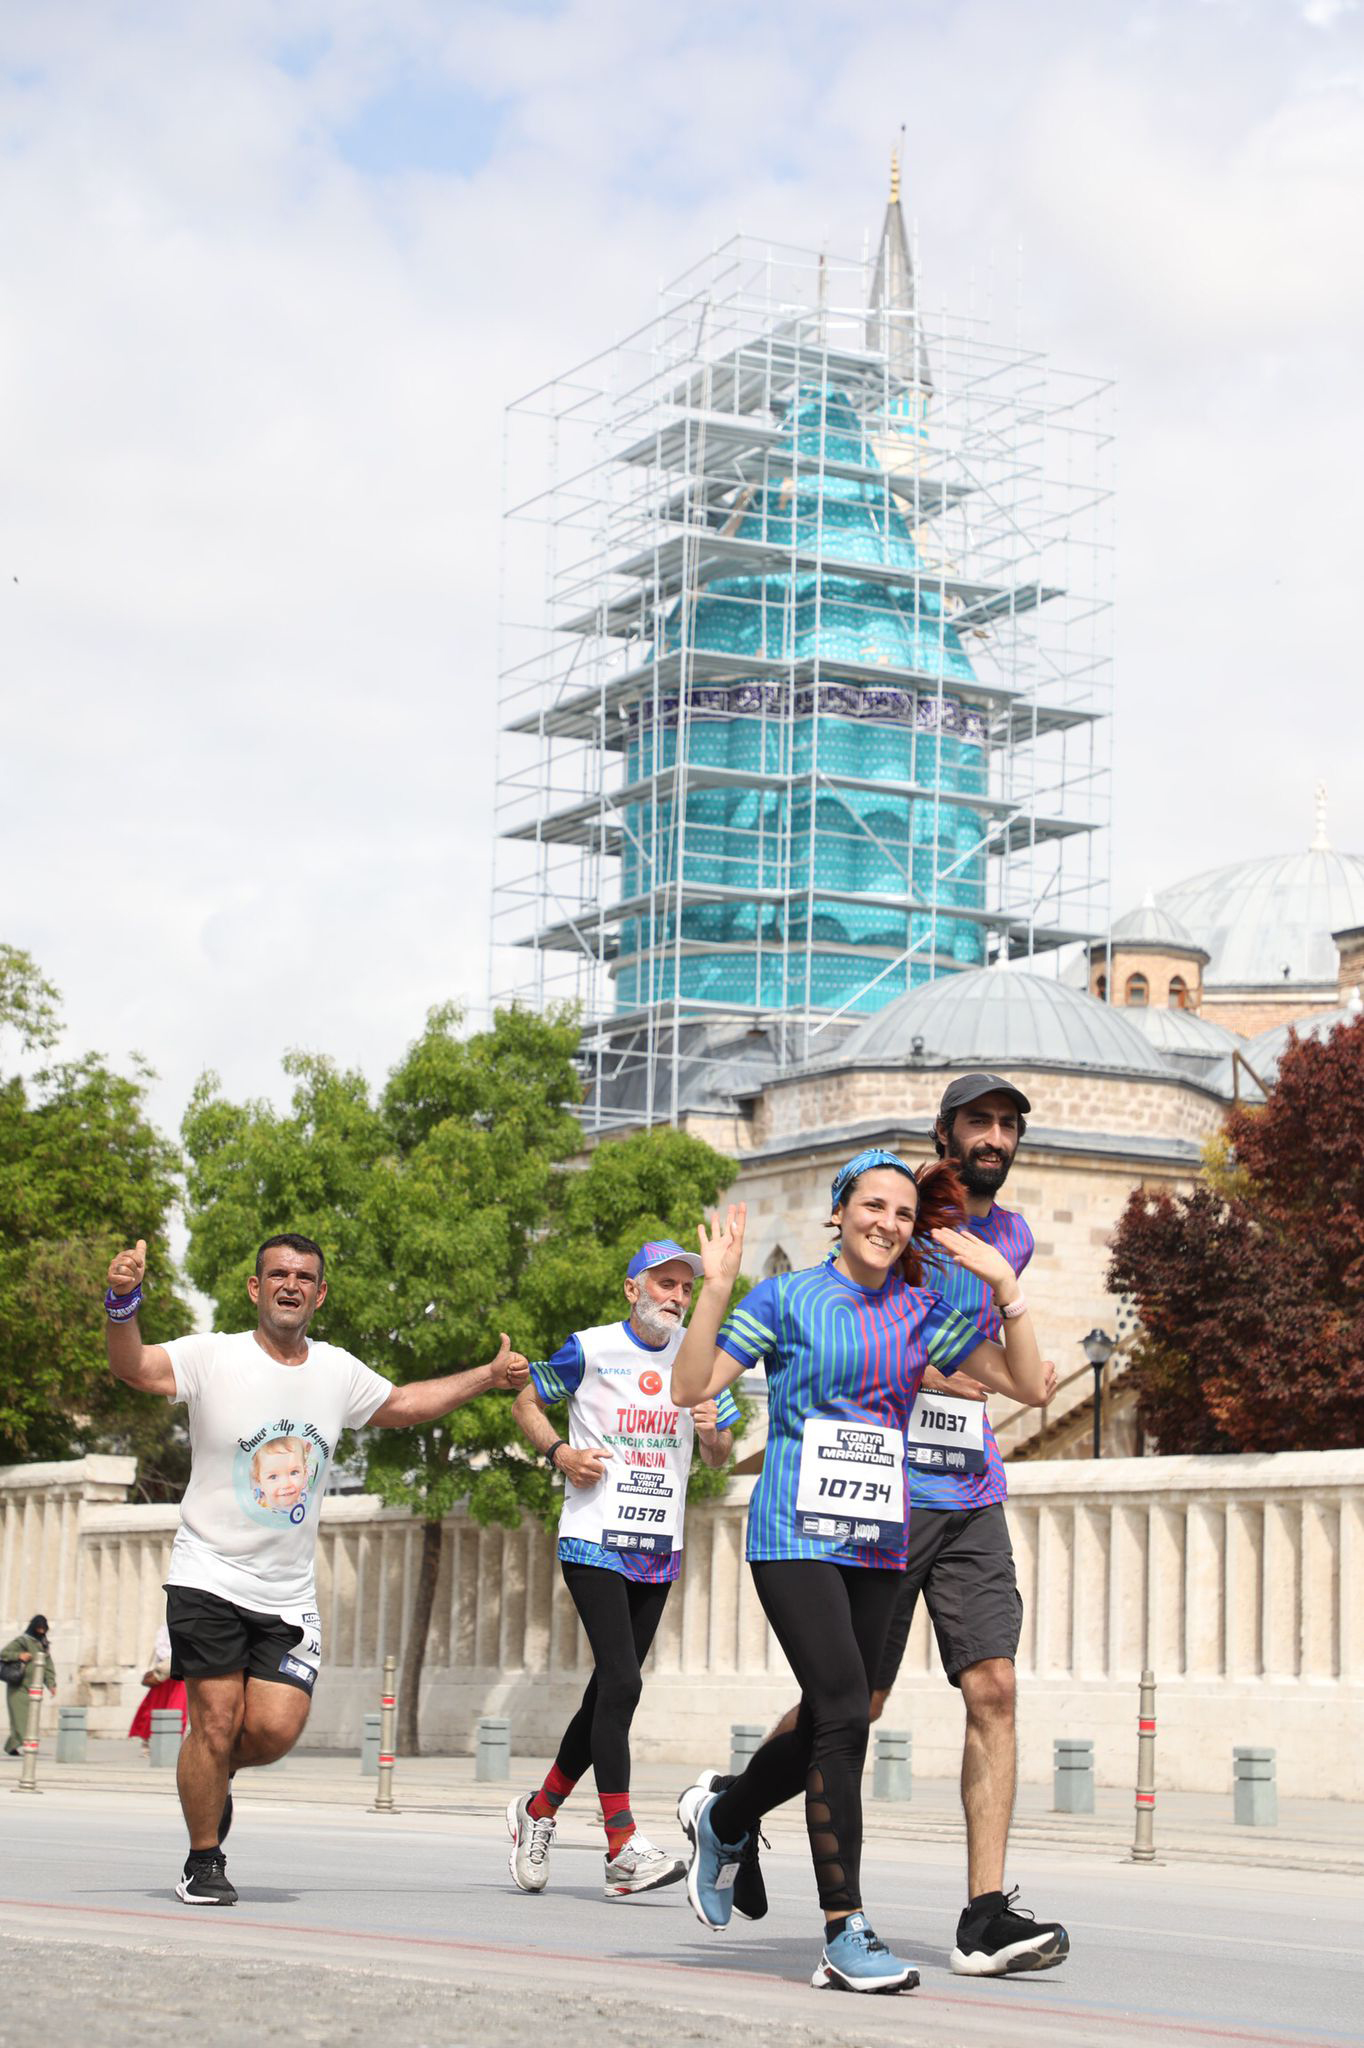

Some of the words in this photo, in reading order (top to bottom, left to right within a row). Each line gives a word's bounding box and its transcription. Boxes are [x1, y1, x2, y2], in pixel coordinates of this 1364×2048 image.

[597, 1367, 632, 1375] KAFKAS
[617, 1403, 679, 1435] TÜRKİYE
[920, 1409, 967, 1433] 11037
[237, 1427, 267, 1453] Ömer
[272, 1418, 295, 1436] Alp
[840, 1431, 882, 1445] KONYA
[848, 1441, 877, 1453] YARI
[624, 1449, 666, 1468] SAMSUN
[821, 1448, 892, 1465] MARATONU
[632, 1472, 663, 1482] KONYA
[637, 1480, 658, 1488] YARI
[620, 1484, 671, 1496] MARATONU
[818, 1477, 892, 1504] 10734
[617, 1505, 667, 1523] 10578
